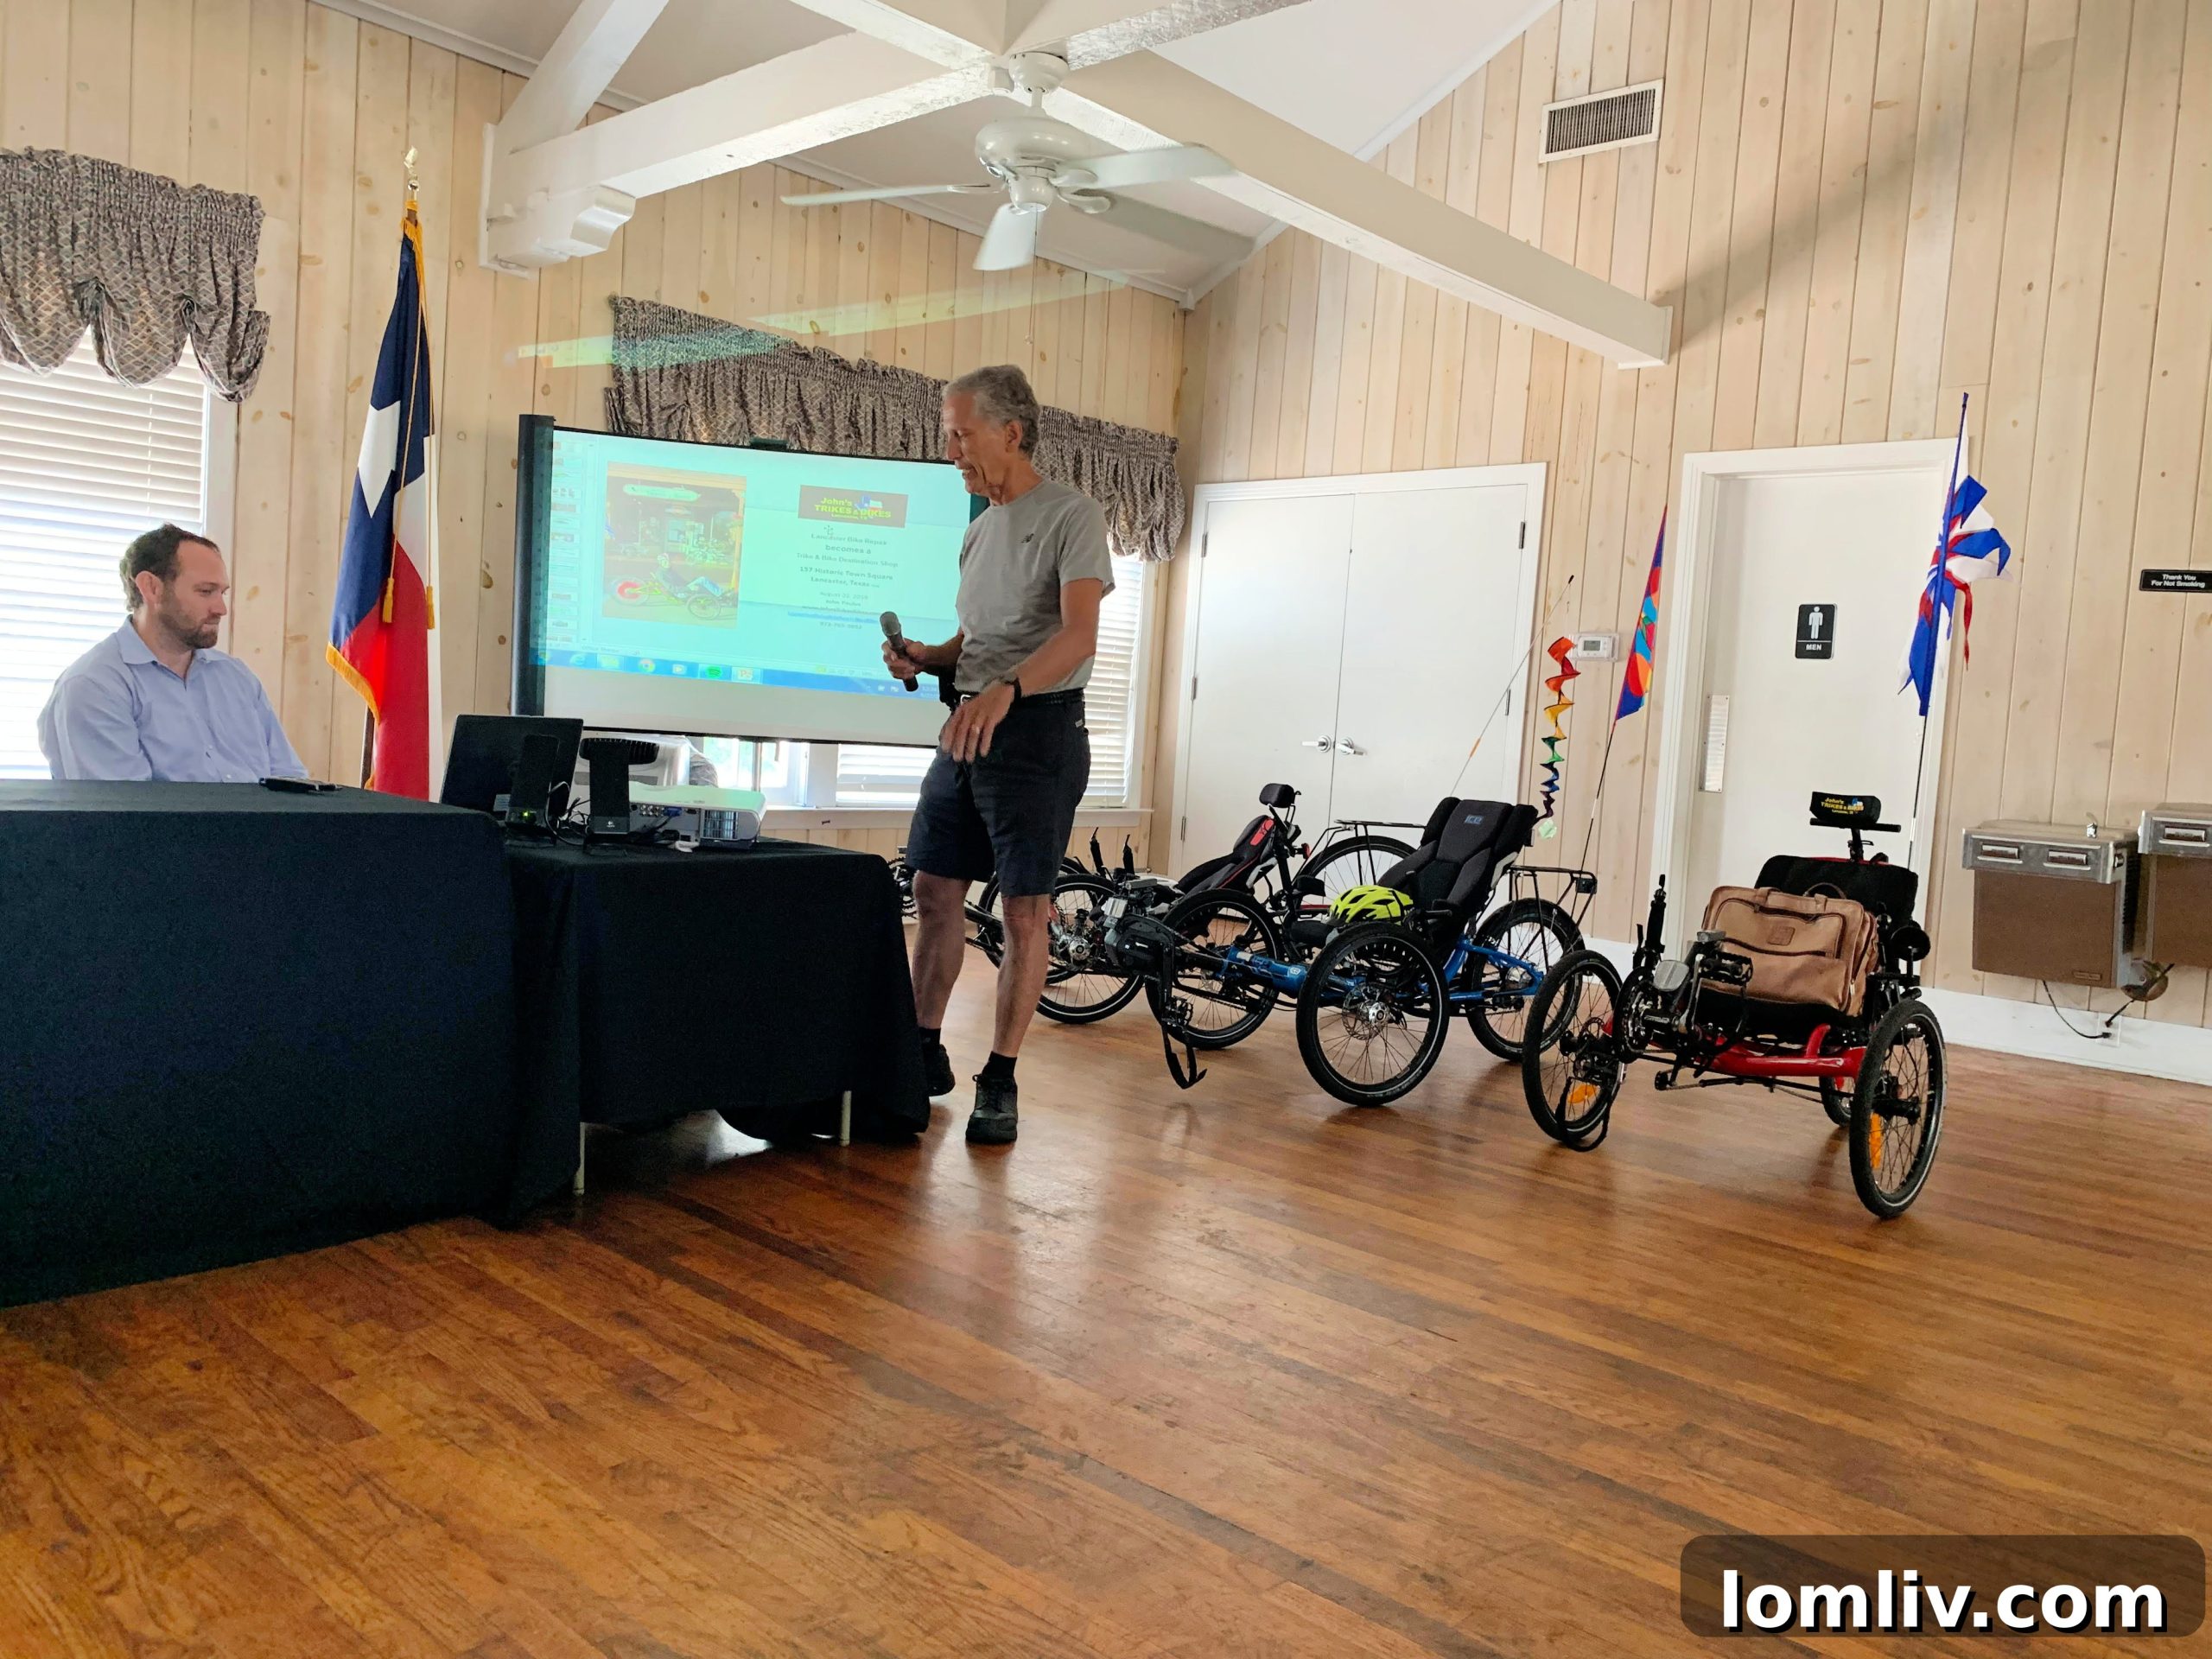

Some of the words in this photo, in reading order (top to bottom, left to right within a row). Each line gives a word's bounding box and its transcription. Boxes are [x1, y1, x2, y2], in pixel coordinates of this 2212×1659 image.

[821, 497, 853, 506] John's
[814, 504, 852, 515] TRIKES
[847, 536, 863, 544] Bike
[825, 544, 864, 554] becomes
[838, 556, 879, 567] Destination
[815, 568, 843, 576] Historic
[867, 572, 893, 582] Square
